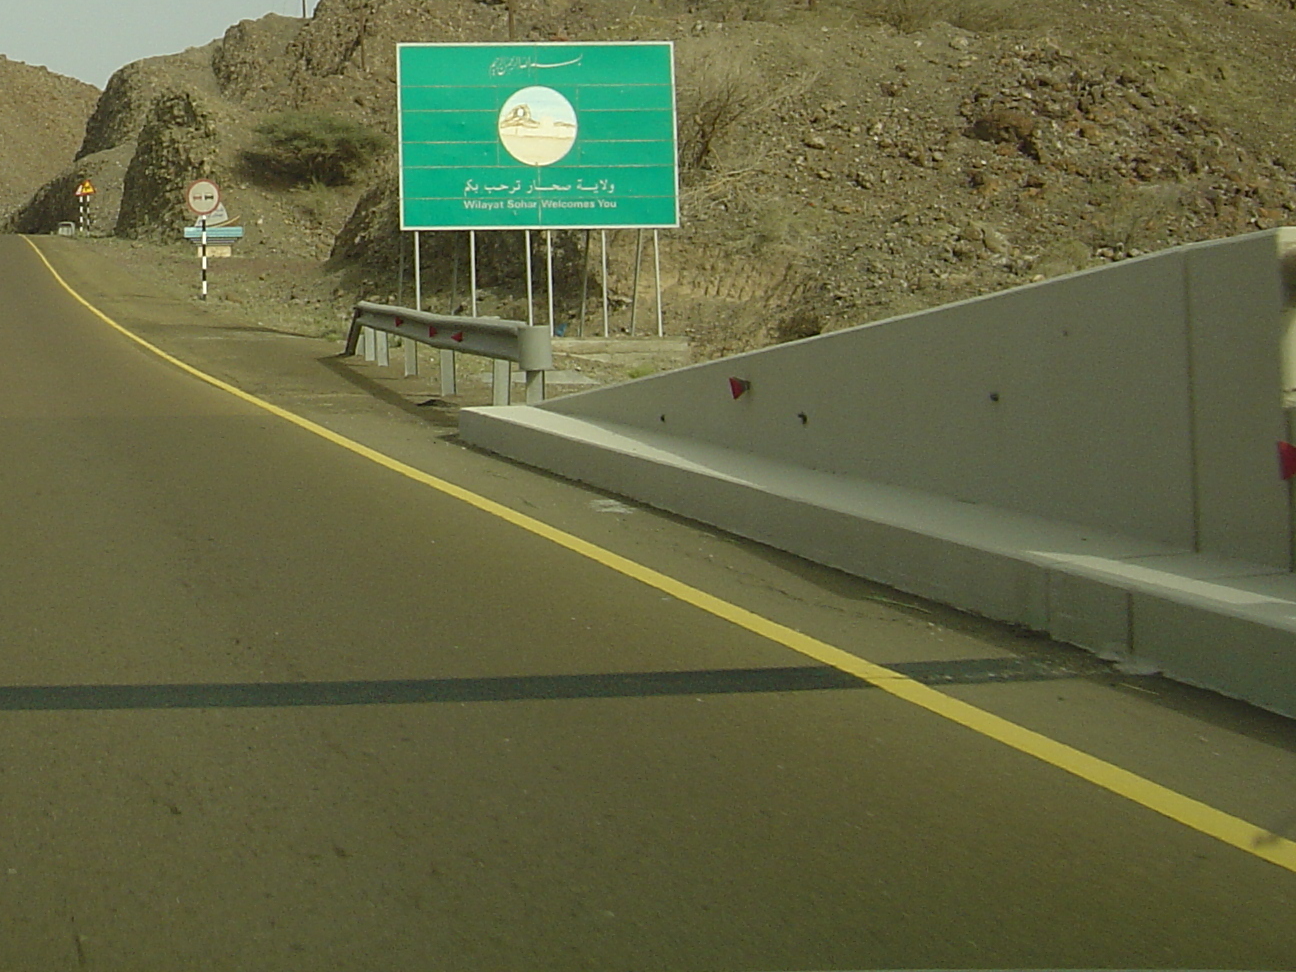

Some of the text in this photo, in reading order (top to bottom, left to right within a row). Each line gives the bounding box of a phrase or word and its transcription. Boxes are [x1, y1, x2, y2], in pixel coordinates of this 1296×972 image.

[464, 179, 615, 197] ولاية صحار ترحب بكم
[463, 199, 617, 211] Wilayat Sohar Welcomes You
